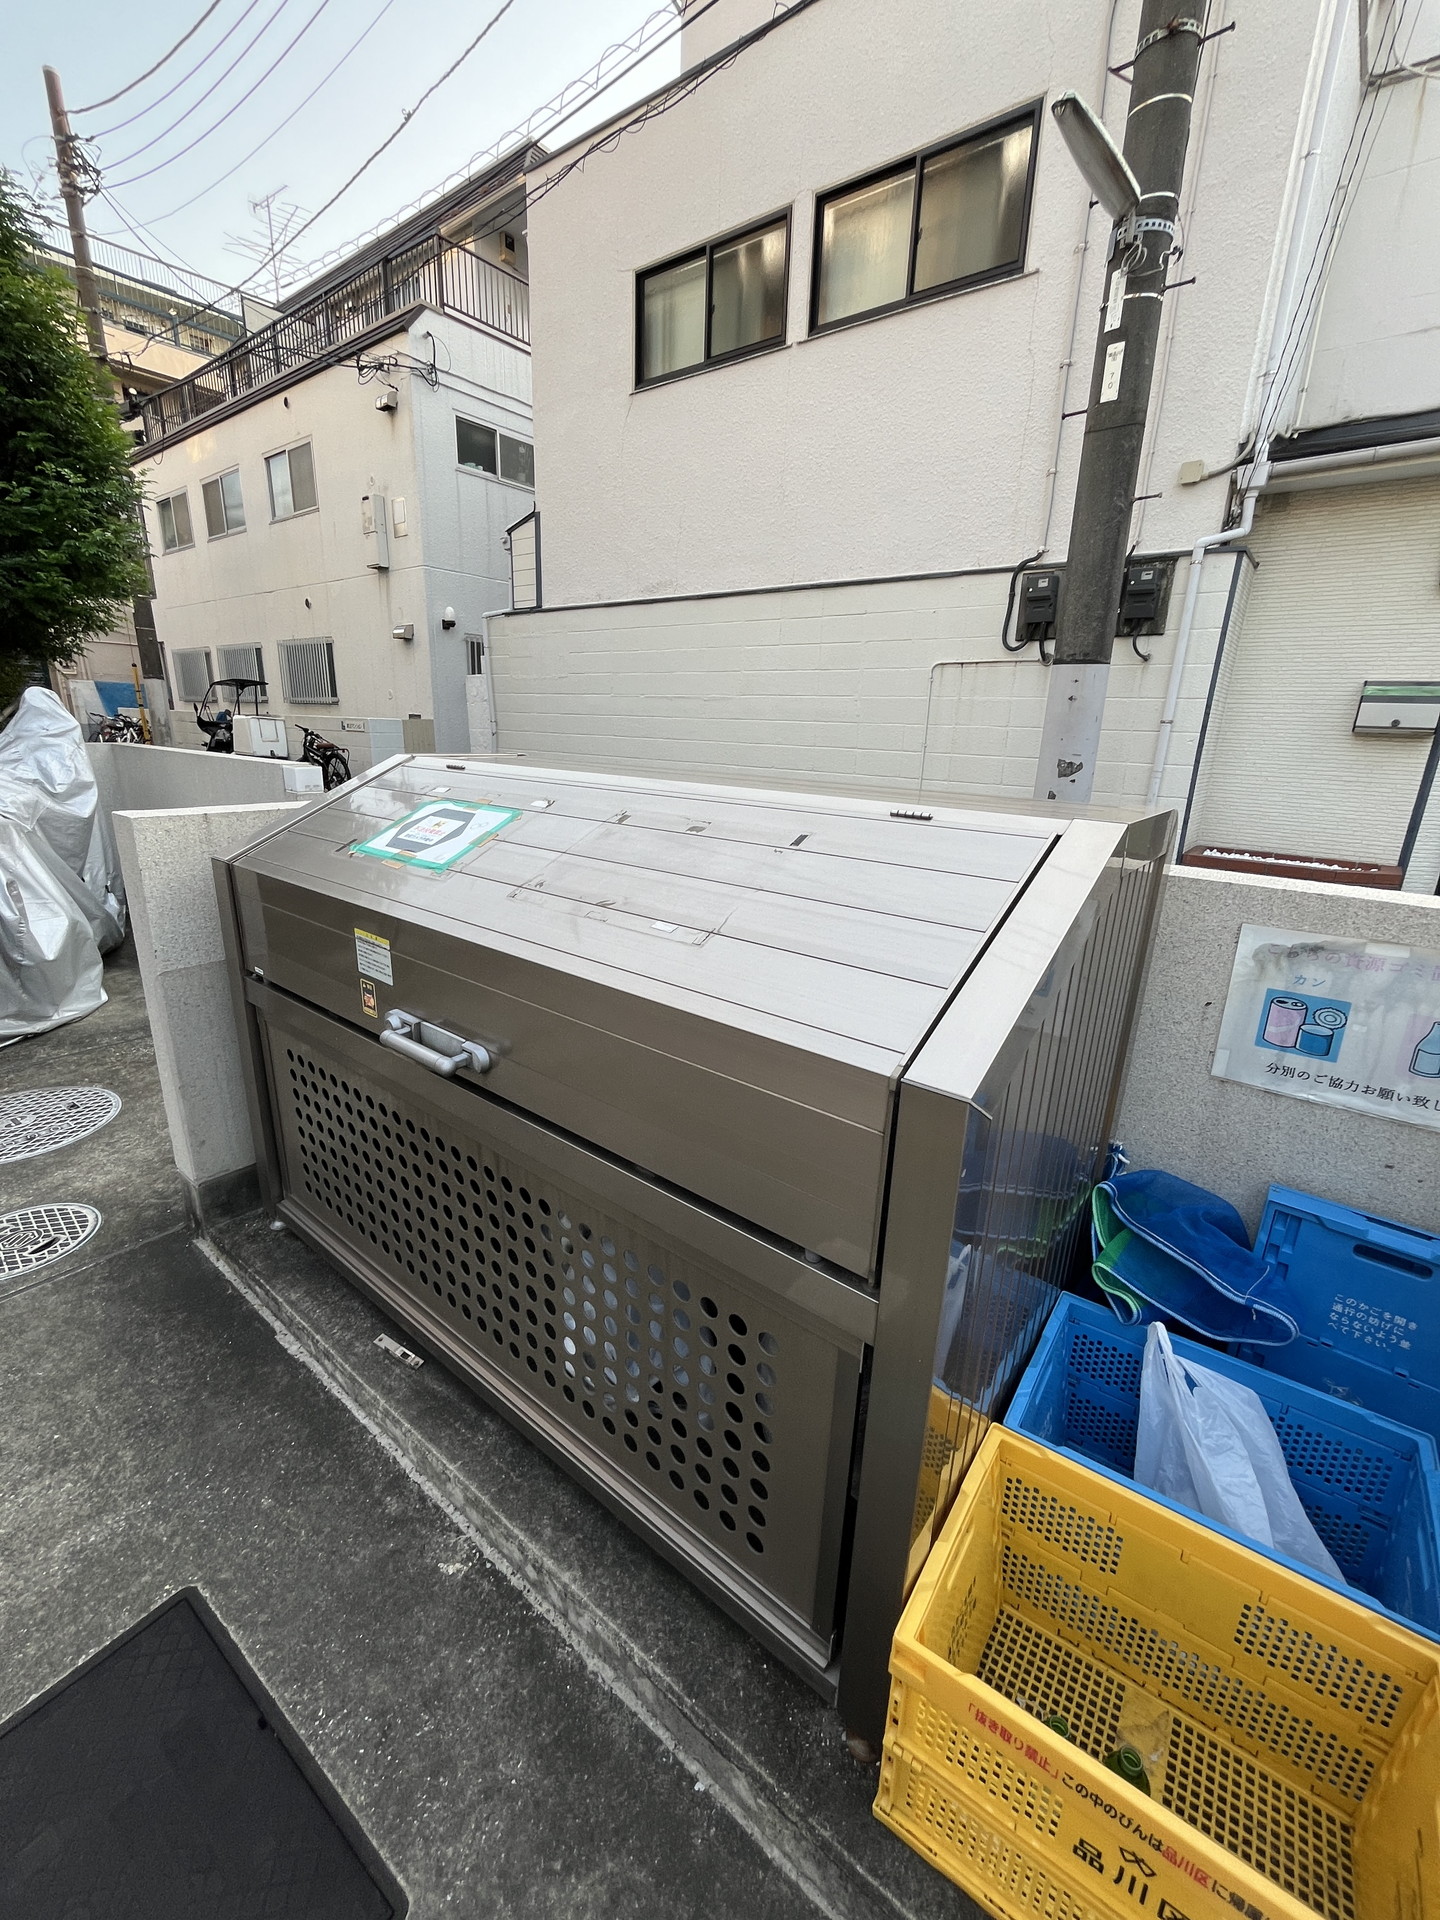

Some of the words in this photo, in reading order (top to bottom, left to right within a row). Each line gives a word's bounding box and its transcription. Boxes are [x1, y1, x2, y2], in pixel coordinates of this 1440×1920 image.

[1293, 974, 1326, 988] カン
[1331, 1302, 1404, 1336] 通行の妨げに
[1334, 1294, 1418, 1331] このかごを開き
[1328, 1322, 1392, 1353] べて下さい。
[1329, 1312, 1411, 1350] ならないよう並
